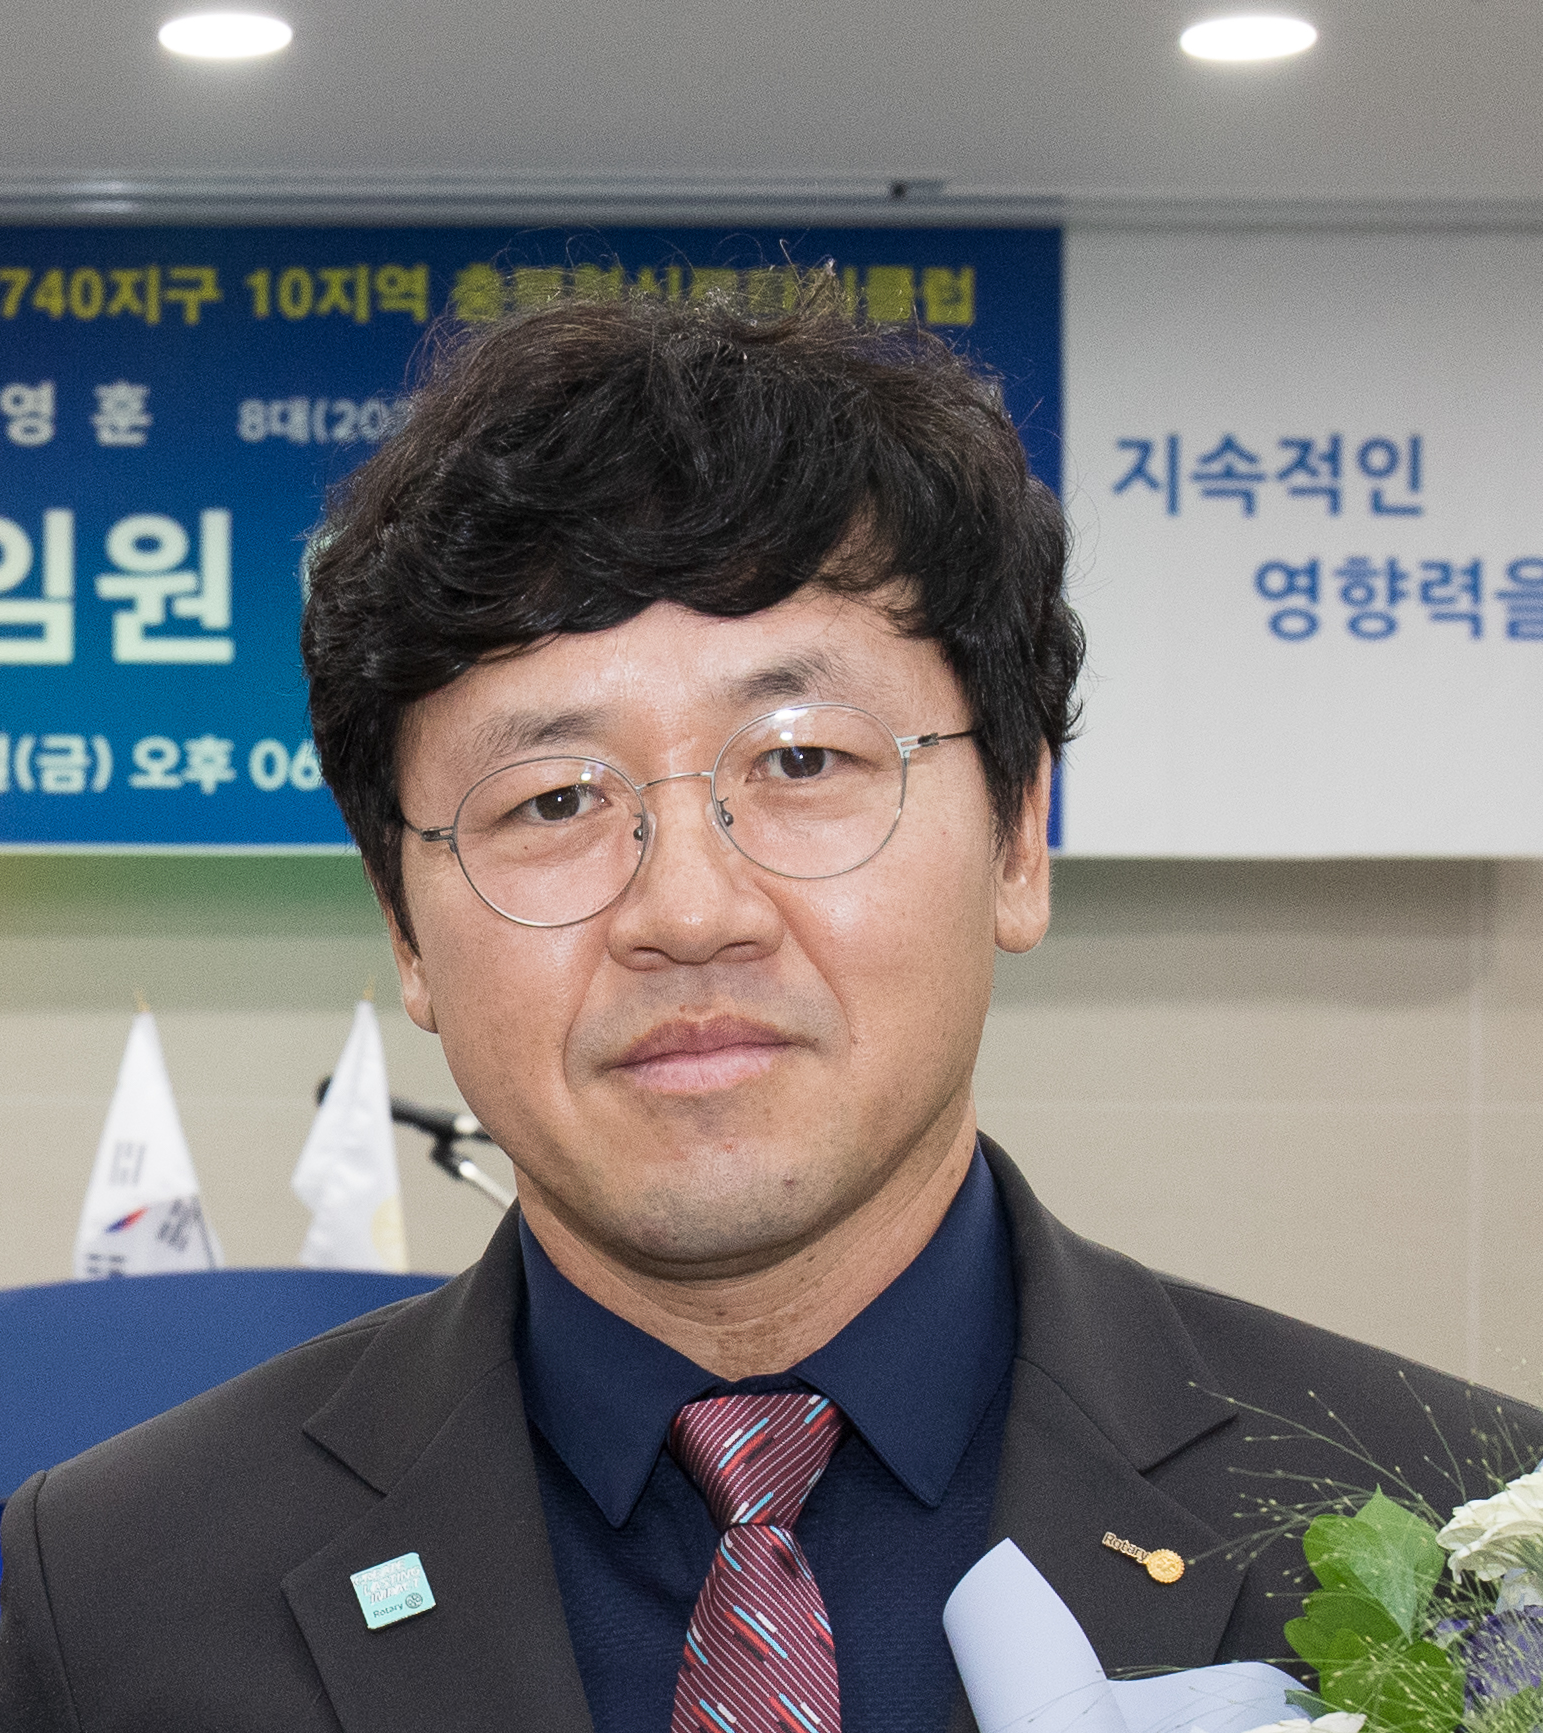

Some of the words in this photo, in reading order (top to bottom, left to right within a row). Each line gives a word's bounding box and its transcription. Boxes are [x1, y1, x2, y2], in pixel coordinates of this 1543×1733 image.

[245, 264, 429, 325] 10지역
[0, 381, 56, 449] 영
[91, 382, 152, 450] 훈
[1112, 432, 1427, 519] 지속적인
[127, 733, 238, 797] 오후
[1102, 1531, 1150, 1563] Rotary
[373, 1603, 403, 1618] Rotary
